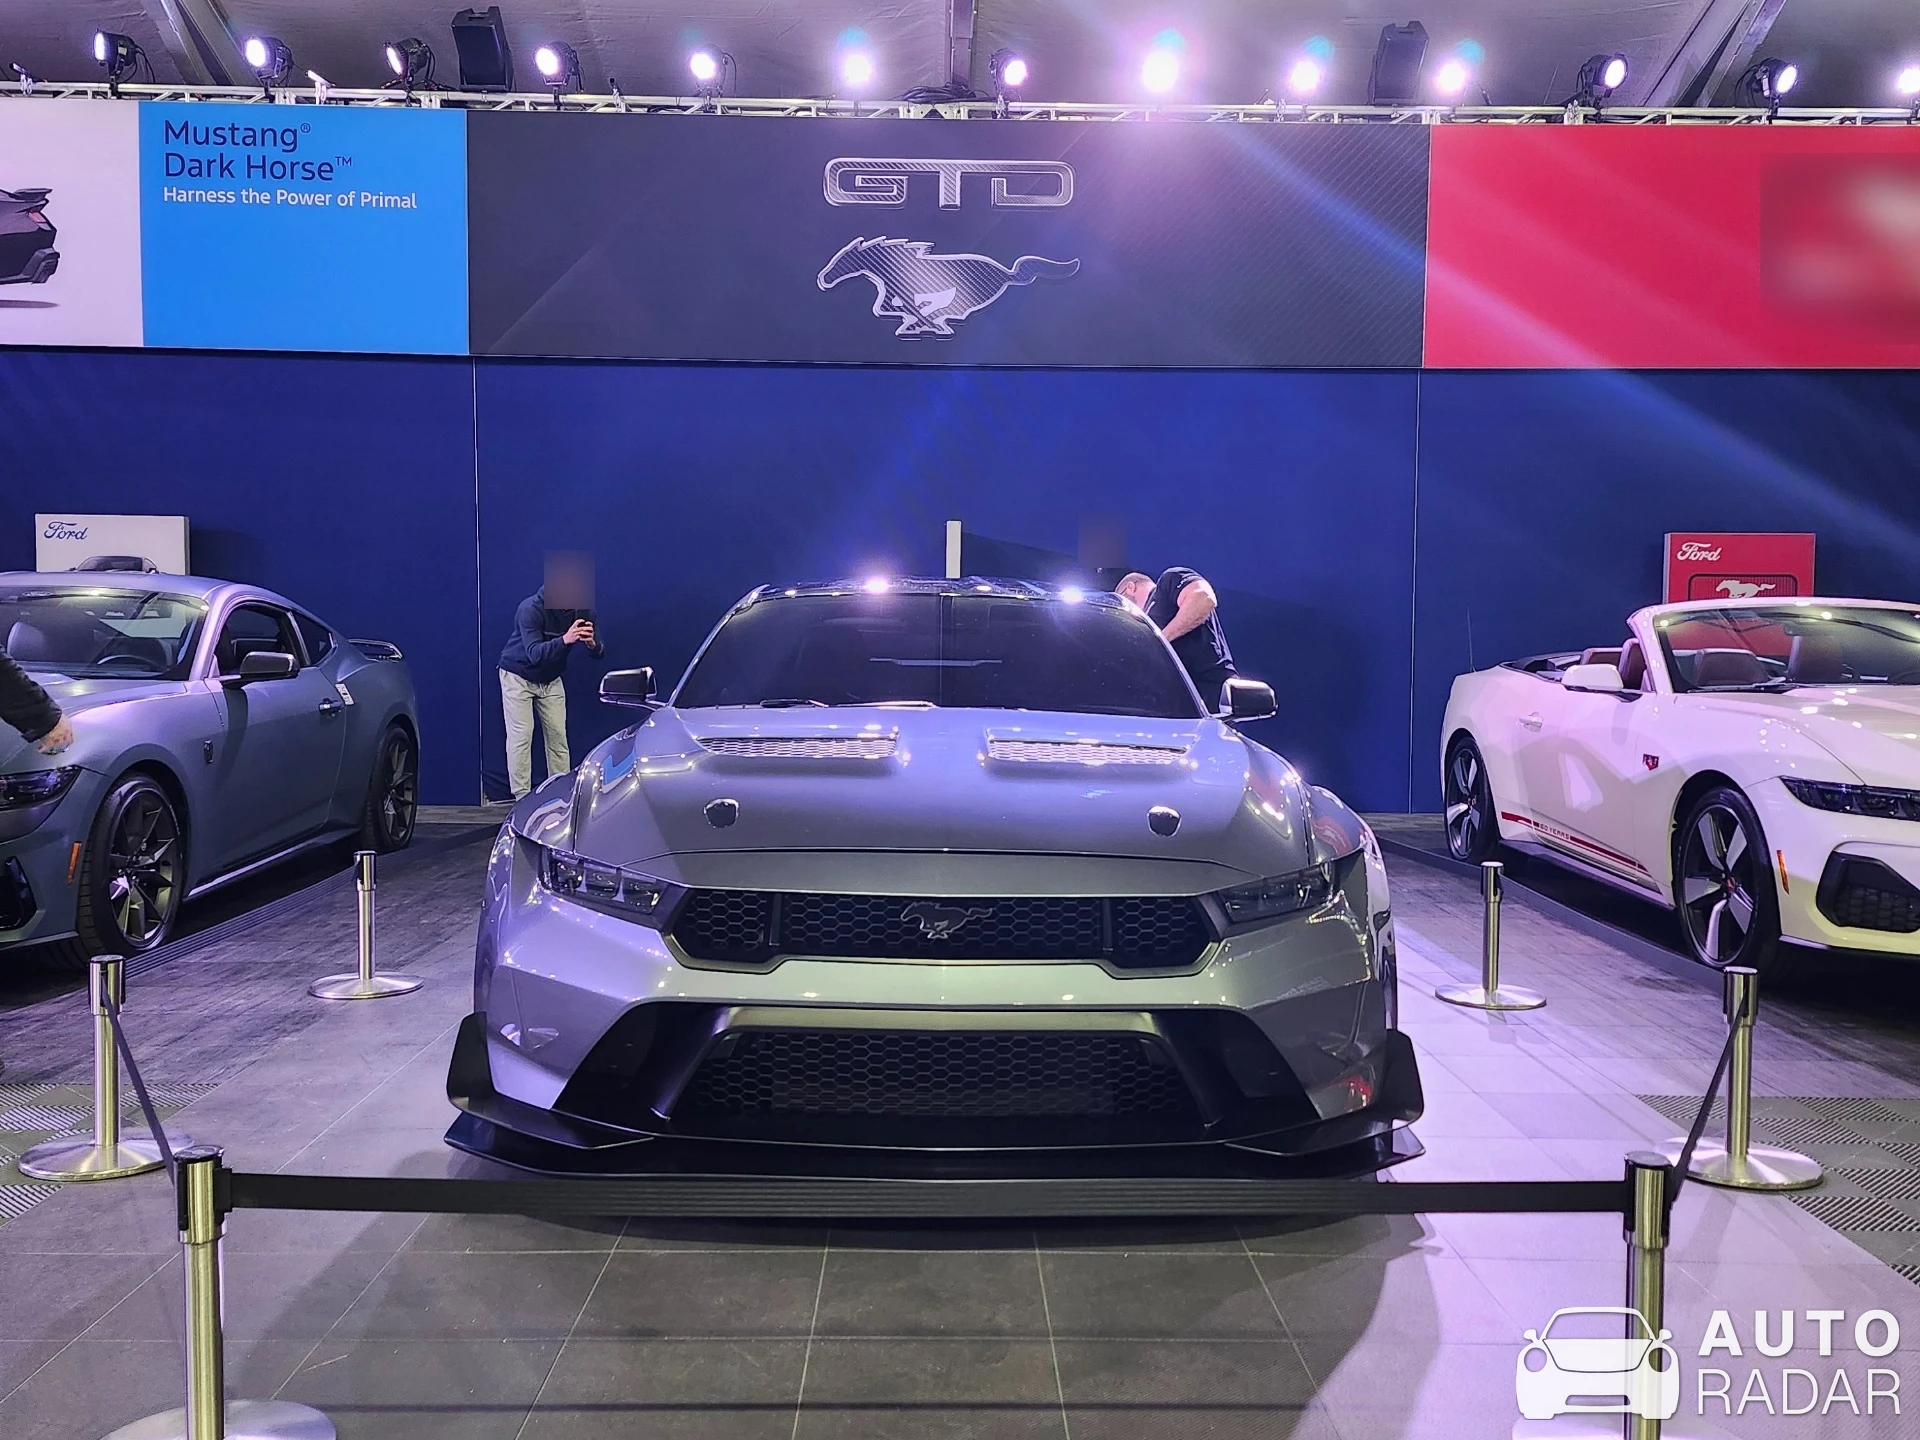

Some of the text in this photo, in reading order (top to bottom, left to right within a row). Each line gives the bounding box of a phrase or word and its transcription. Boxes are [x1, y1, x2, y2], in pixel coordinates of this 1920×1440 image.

[164, 152, 236, 179] Dark
[822, 157, 1076, 210] GTD
[163, 186, 418, 209] Harness the Power of Primal
[43, 521, 89, 541] Ford
[1676, 541, 1723, 562] Ford
